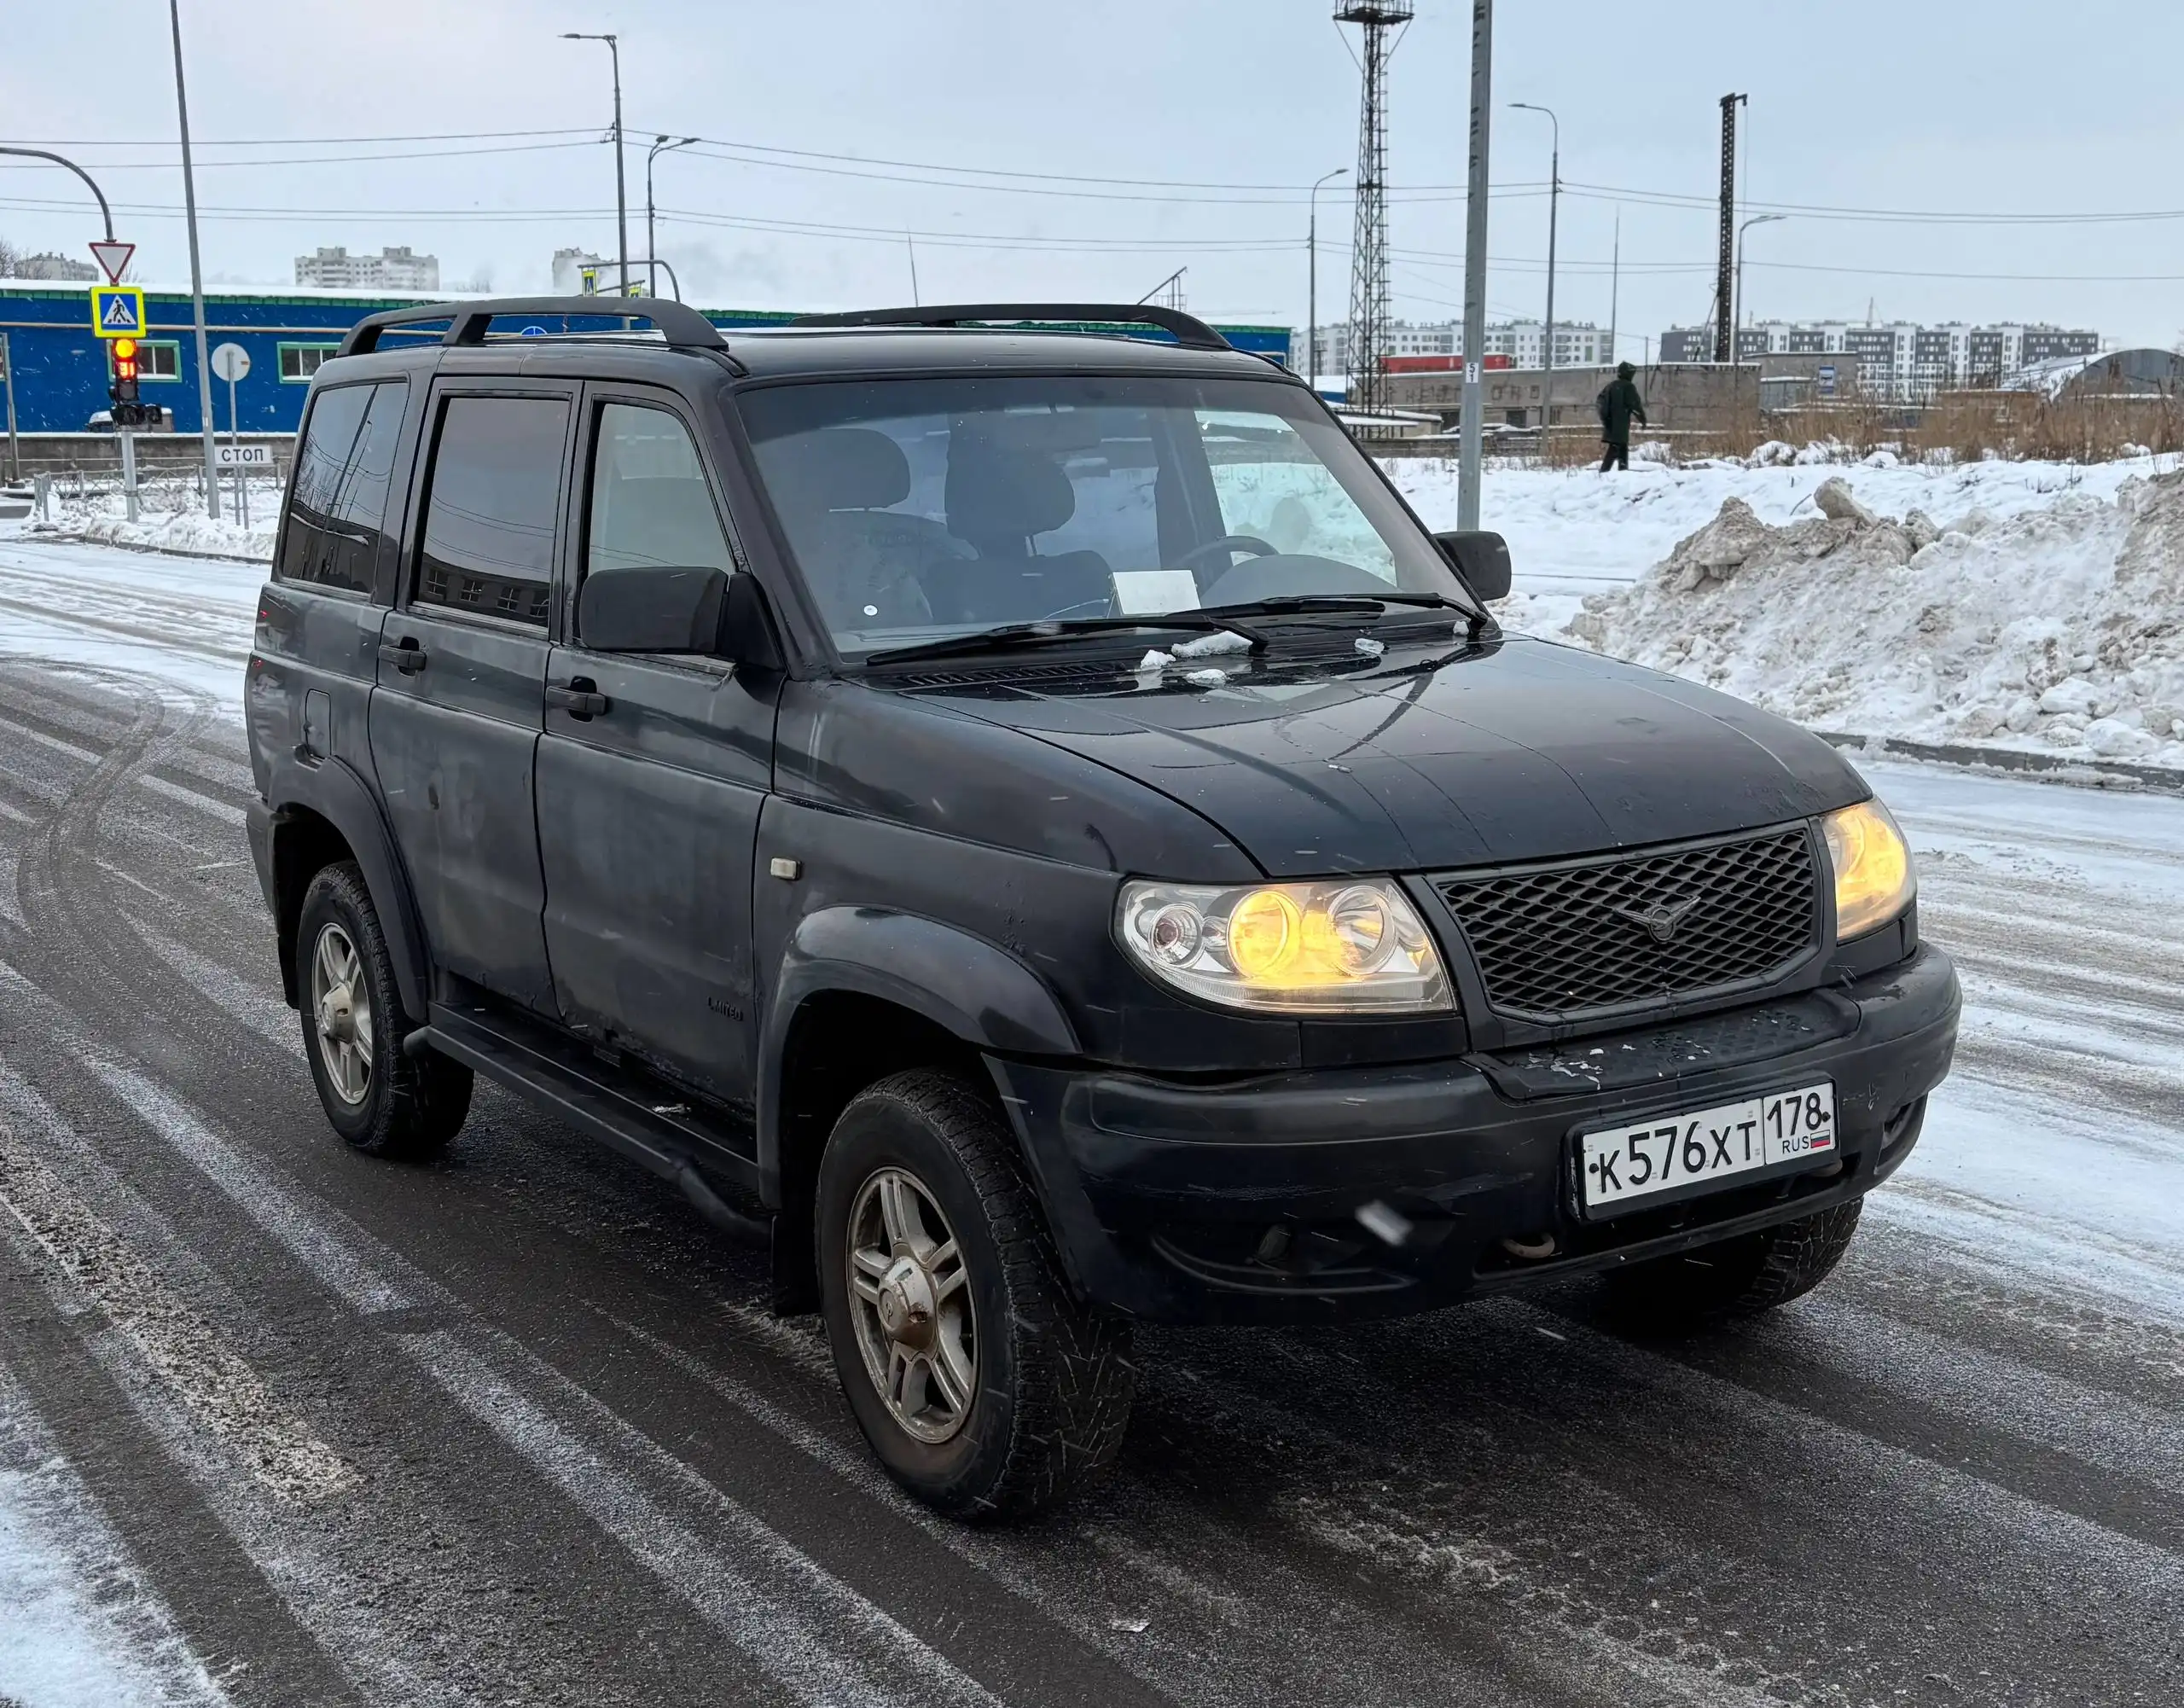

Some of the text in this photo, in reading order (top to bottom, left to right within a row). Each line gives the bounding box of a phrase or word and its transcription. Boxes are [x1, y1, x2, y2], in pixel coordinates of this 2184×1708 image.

[222, 449, 264, 462] СТОП
[1766, 1092, 1822, 1139] 178
[1781, 1136, 1809, 1154] RUS
